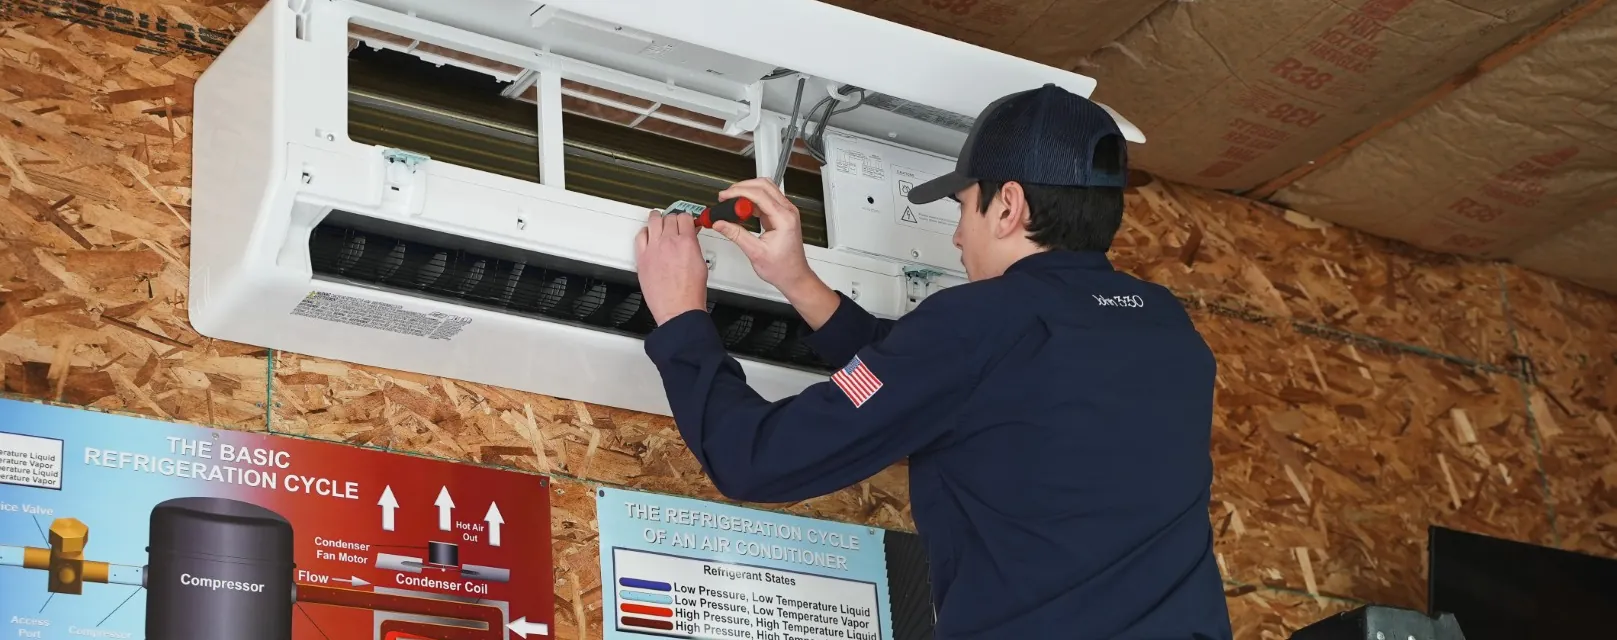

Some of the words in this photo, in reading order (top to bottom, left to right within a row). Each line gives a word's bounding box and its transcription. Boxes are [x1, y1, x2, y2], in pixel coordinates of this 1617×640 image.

[1270, 57, 1334, 90] R38
[30, 452, 55, 462] Liquid
[166, 436, 213, 459] THE
[220, 444, 291, 469] BASIC
[0, 466, 30, 474] erature
[33, 468, 58, 478] Liquid
[30, 460, 54, 469] Vapor
[0, 474, 30, 482] erature
[33, 476, 56, 485] Vapor
[84, 447, 278, 489] REFRIGERATION
[284, 474, 359, 500] CYCLE
[22, 503, 54, 516] Valve
[456, 521, 471, 531] Hot
[472, 523, 485, 532] Air
[625, 501, 661, 521] THE
[665, 507, 802, 541] REFRIGERATION
[807, 528, 860, 551] CYCLE
[314, 537, 370, 552] Condenser
[463, 533, 478, 543] Out
[316, 550, 336, 561] Fan
[338, 551, 368, 565] Motor
[643, 527, 667, 544] OF
[671, 532, 697, 549] AN
[700, 536, 731, 553] AIR
[735, 539, 849, 571] CONDITIONER
[180, 573, 265, 593] Compressor
[298, 570, 329, 584] Flow
[396, 573, 462, 592] Condenser
[464, 581, 488, 595] Coil
[703, 565, 762, 581] Refrigerant
[764, 572, 796, 586] States
[674, 582, 696, 594] Low
[699, 585, 749, 602] Pressure,
[752, 591, 773, 604] Low
[776, 594, 838, 613] Temperature
[840, 604, 870, 618] Liquid
[675, 595, 697, 607] Low
[700, 598, 750, 615] Pressure,
[753, 604, 774, 616] Low
[777, 607, 838, 625] Temperature
[840, 616, 870, 630] Vapor
[11, 616, 50, 627] Access
[675, 607, 700, 621] High
[703, 611, 753, 628] Pressure,
[756, 617, 780, 631] High
[782, 620, 844, 638] Temperature
[846, 629, 877, 640] Liquid
[18, 628, 41, 638] Port
[676, 621, 701, 634] High
[704, 623, 754, 639] Pressure,
[757, 630, 780, 640] High
